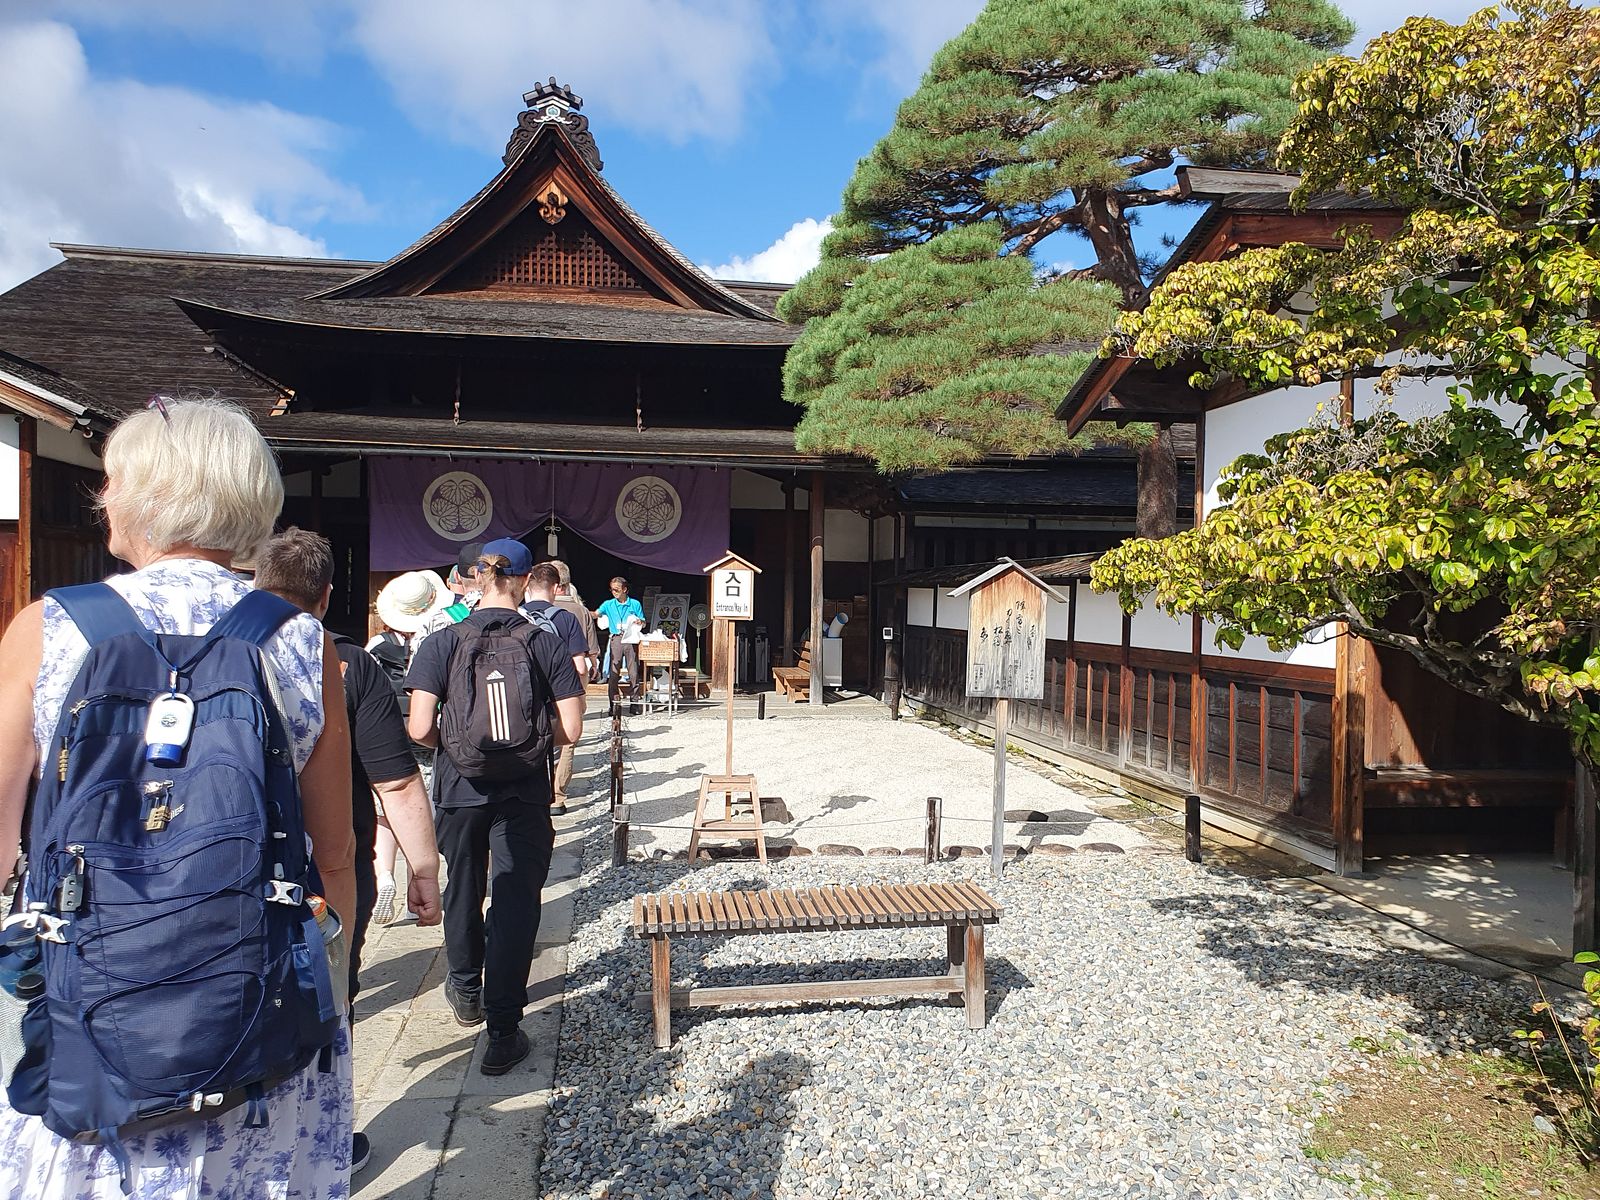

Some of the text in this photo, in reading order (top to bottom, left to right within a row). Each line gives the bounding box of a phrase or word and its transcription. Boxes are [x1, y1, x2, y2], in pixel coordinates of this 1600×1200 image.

[725, 572, 741, 597] 入口
[716, 602, 748, 613] Entrance Way In
[274, 998, 282, 1008] 45
